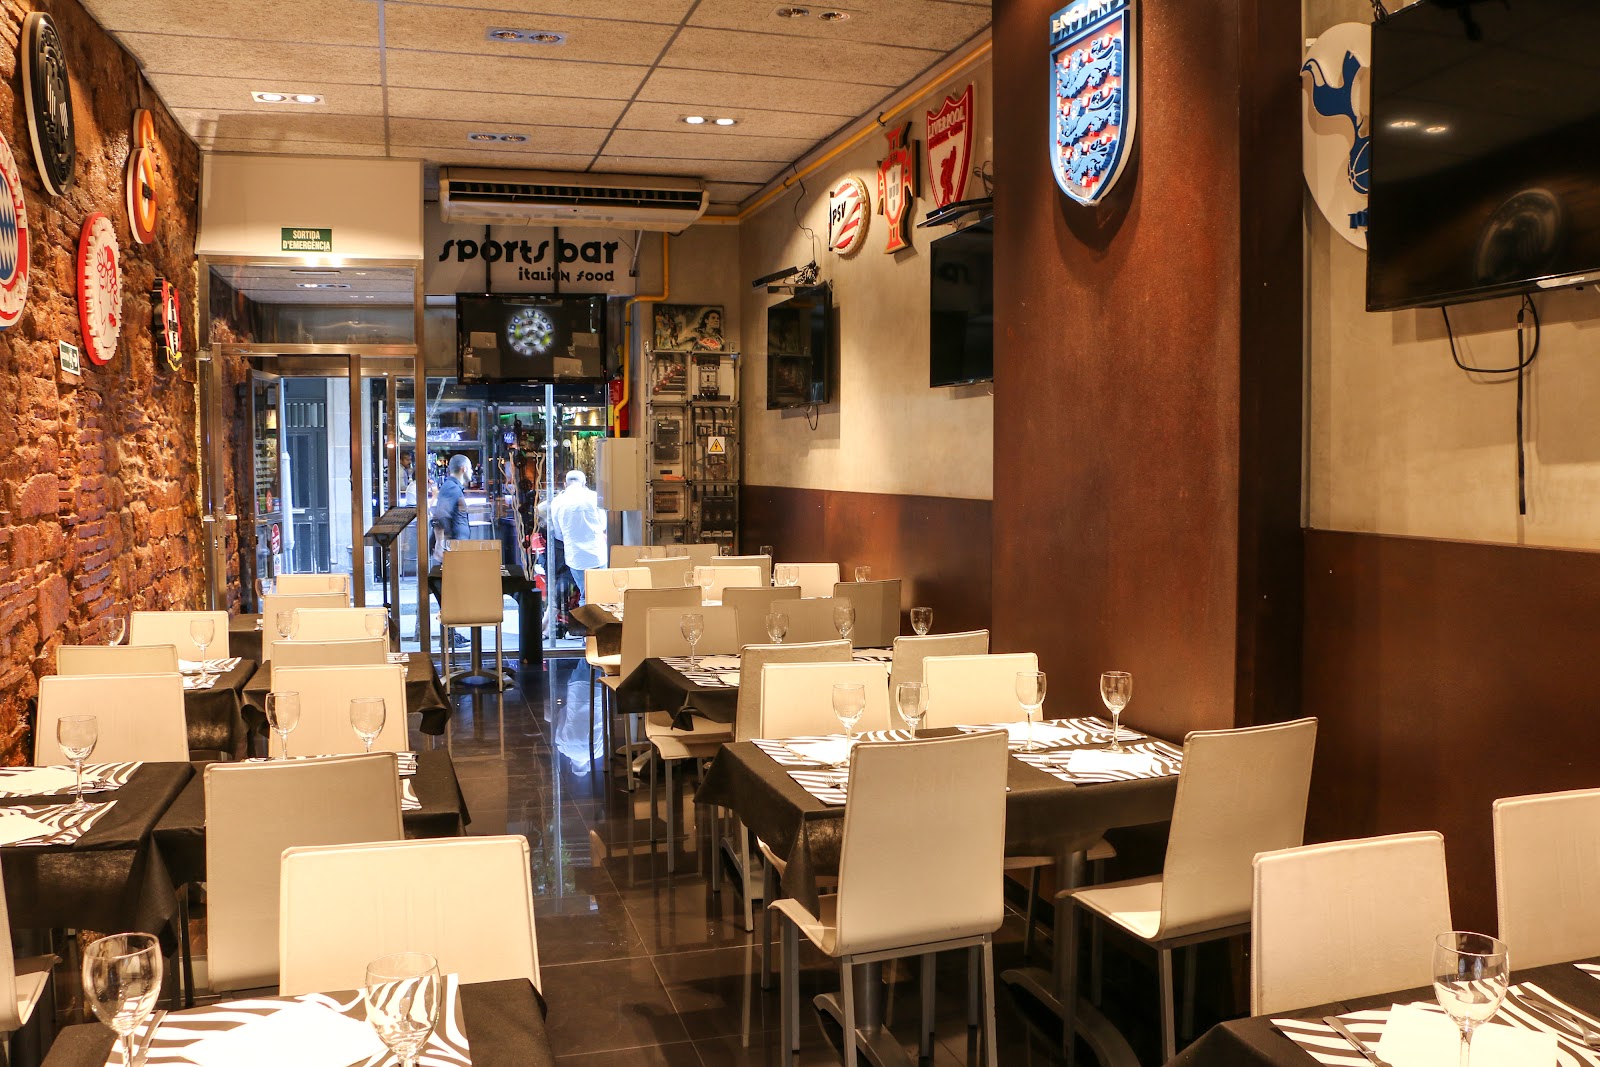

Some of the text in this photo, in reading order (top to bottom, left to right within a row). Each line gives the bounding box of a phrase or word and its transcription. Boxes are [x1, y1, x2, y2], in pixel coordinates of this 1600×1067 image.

[928, 105, 966, 139] LIVERPOOL
[832, 201, 846, 226] PSV
[292, 230, 321, 240] SORTIDA
[438, 239, 618, 264] sports bar
[576, 270, 615, 282] food
